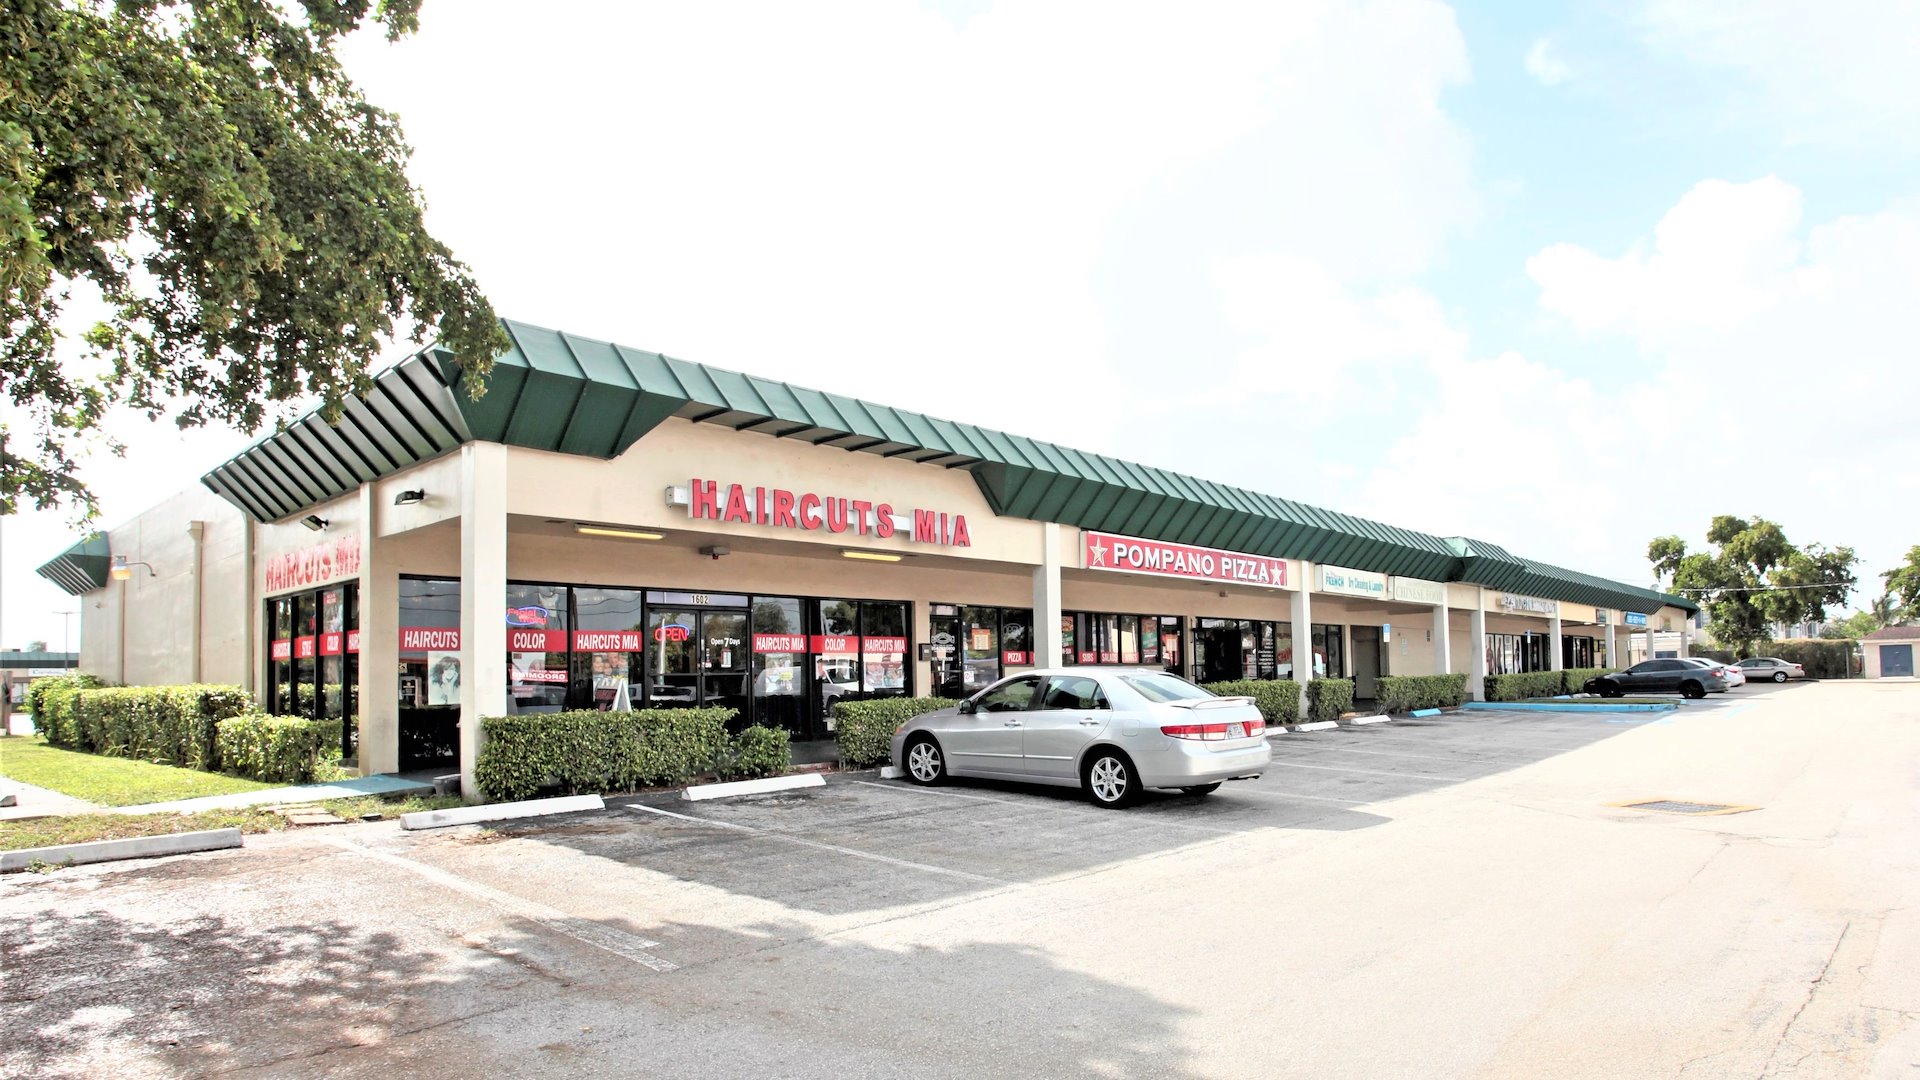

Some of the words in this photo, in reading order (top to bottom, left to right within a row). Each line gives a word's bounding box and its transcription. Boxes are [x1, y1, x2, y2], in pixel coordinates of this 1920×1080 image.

[690, 478, 895, 538] HAIRCUTS
[911, 509, 971, 547] MIA
[266, 544, 332, 593] HAIRCUTS
[1113, 542, 1215, 576] POMPANO
[1221, 557, 1269, 582] PIZZA
[692, 595, 709, 604] 1602
[404, 631, 458, 648] HAIRCUTS
[513, 632, 545, 649] COLOR
[654, 628, 688, 641] OPEN
[577, 634, 620, 649] HAIRCUTS
[622, 635, 639, 650] MIA
[711, 638, 724, 646] Open
[724, 638, 729, 647] 7
[729, 638, 740, 646] Days
[756, 637, 790, 650] HAIRCUTS
[792, 638, 804, 650] MIA
[824, 638, 846, 651] COLOR
[865, 639, 893, 651] HAIRCUTS
[894, 640, 905, 651] MIA
[1008, 652, 1022, 662] PIZZA
